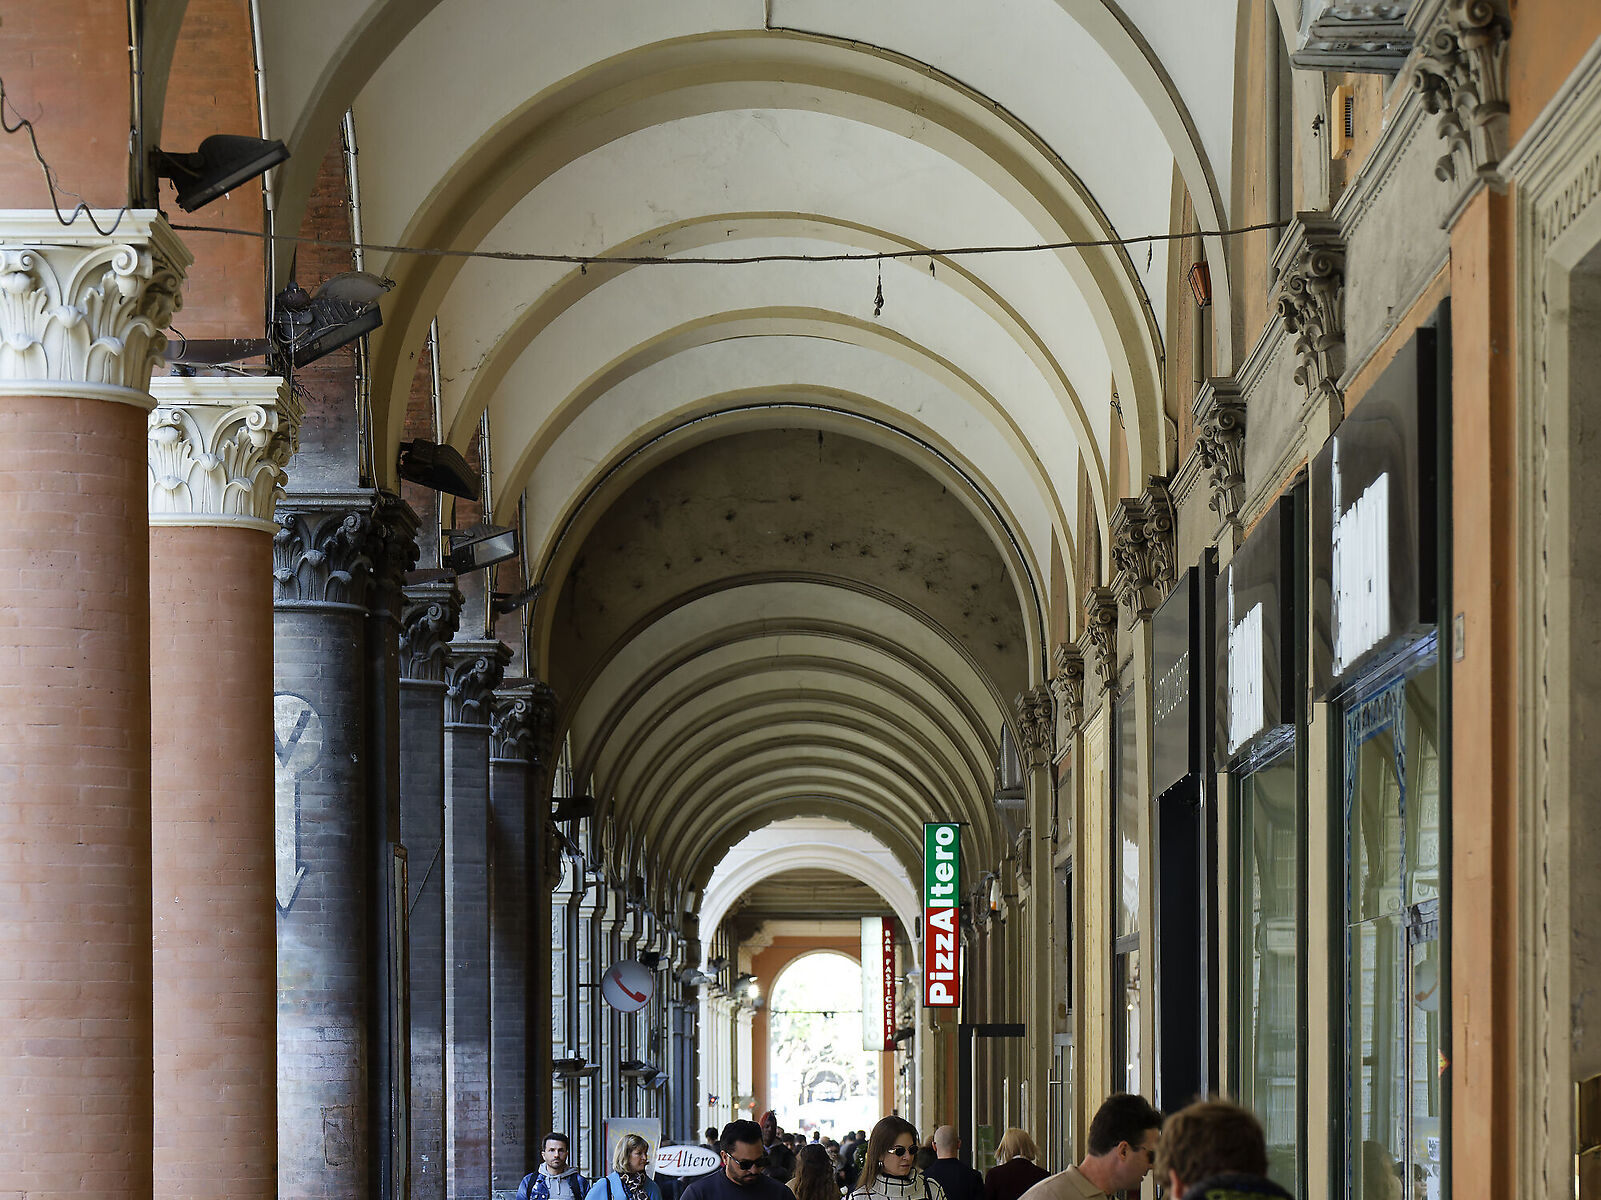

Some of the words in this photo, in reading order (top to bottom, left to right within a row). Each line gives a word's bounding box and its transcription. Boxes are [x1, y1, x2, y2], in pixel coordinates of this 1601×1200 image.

[884, 929, 892, 952] BAR
[929, 826, 955, 1004] PizzAltero
[884, 958, 893, 1040] PASTICCERIA
[656, 1149, 716, 1169] izzAltero
